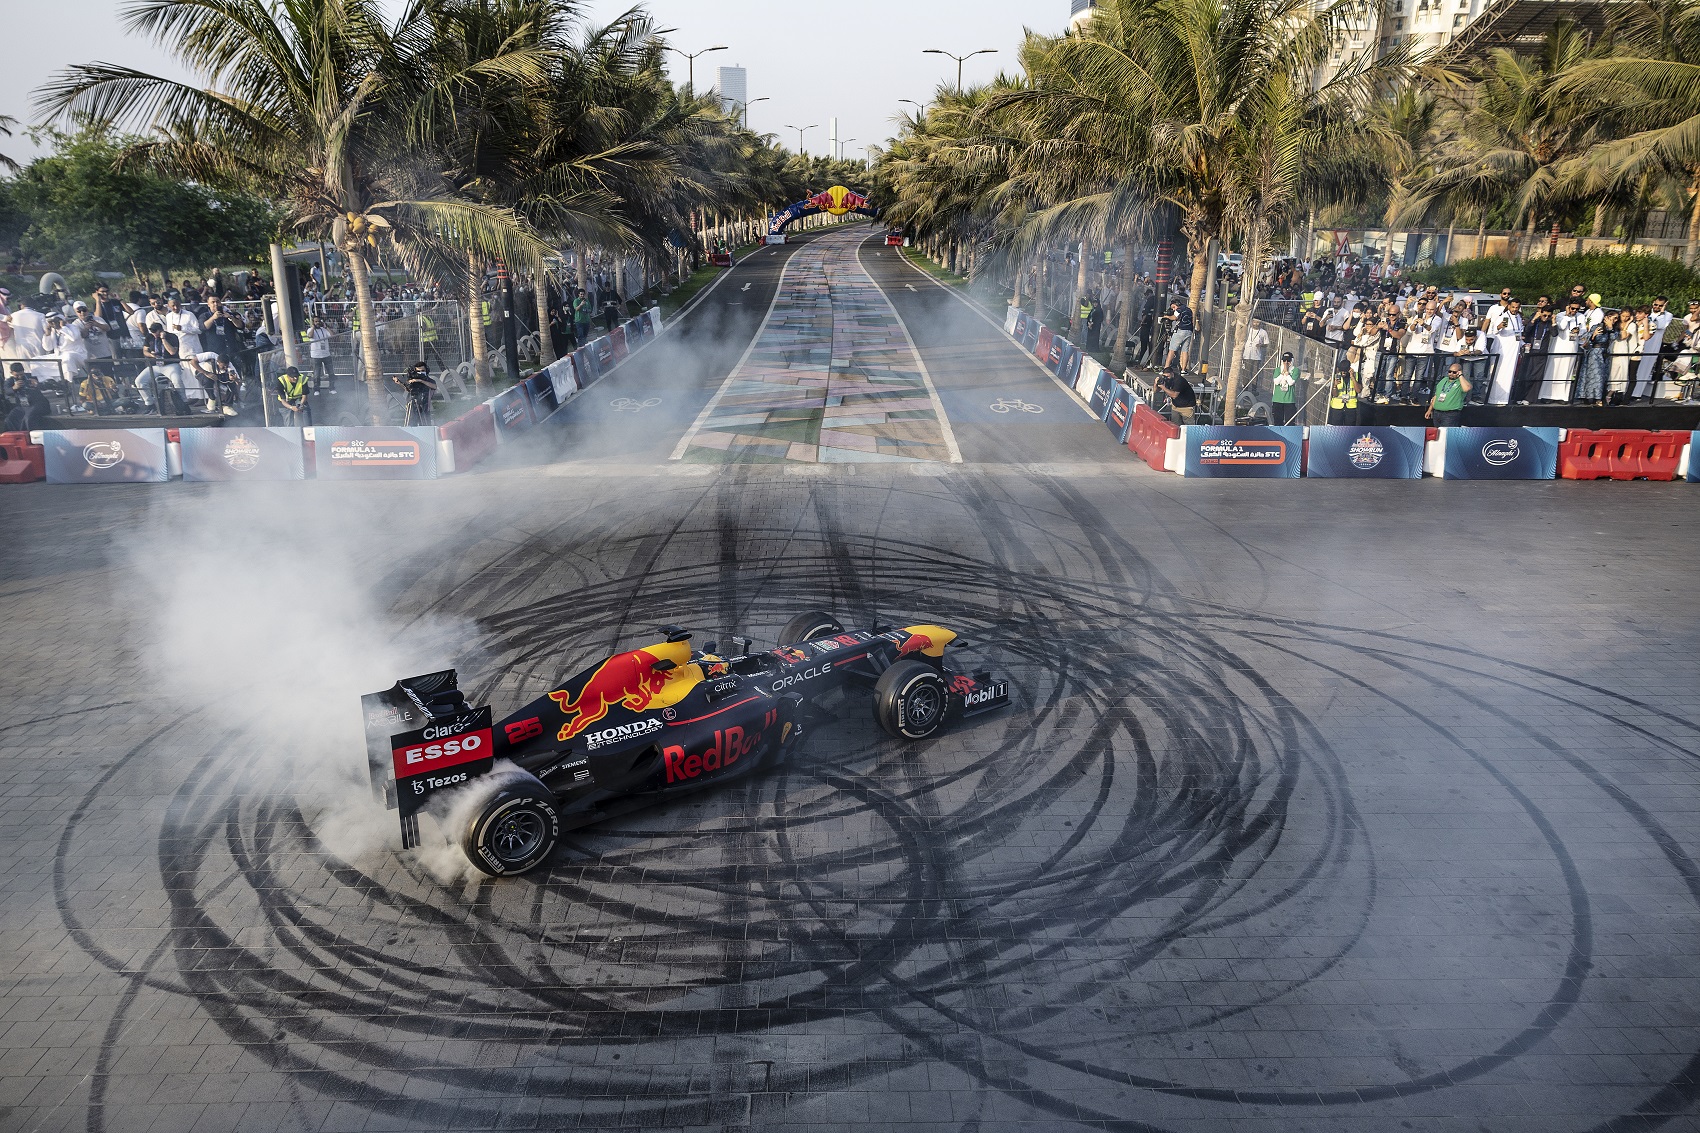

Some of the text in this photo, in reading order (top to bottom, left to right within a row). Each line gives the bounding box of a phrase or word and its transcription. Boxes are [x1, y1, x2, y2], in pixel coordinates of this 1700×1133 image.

[714, 679, 738, 692] citrix
[772, 662, 832, 691] ORACLE
[964, 685, 995, 708] Mobil
[585, 717, 663, 745] HONDA
[406, 735, 482, 765] ESSO
[427, 772, 468, 789] Tezos
